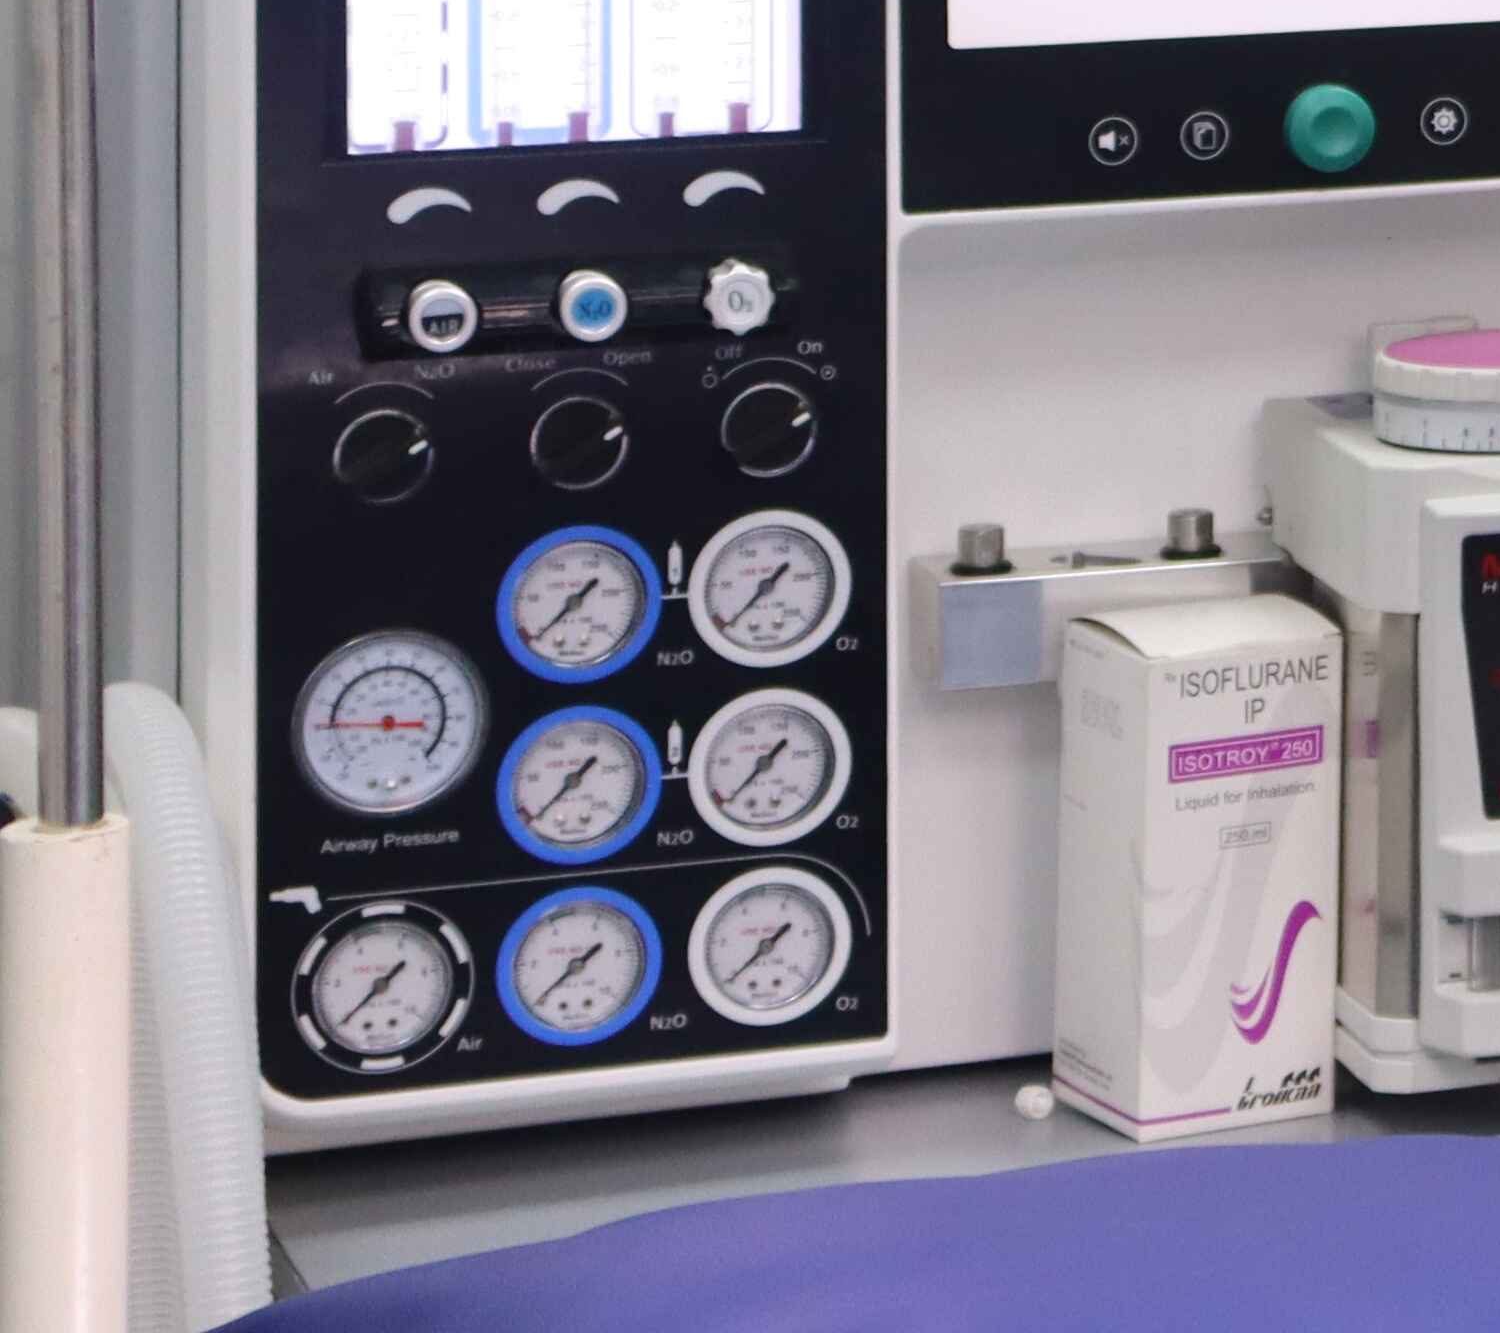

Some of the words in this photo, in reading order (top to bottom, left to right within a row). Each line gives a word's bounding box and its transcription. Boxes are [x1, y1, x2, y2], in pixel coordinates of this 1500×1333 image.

[503, 355, 557, 373] Close
[602, 348, 653, 368] Open
[714, 343, 744, 361] Off
[796, 339, 823, 356] On
[308, 369, 335, 385] Air
[656, 650, 695, 667] N2O
[1179, 655, 1329, 699] ISOFLURANE
[1244, 698, 1266, 724] IP
[1281, 739, 1313, 760] 250
[1175, 794, 1220, 813] Liquid
[1223, 790, 1244, 805] for
[1248, 781, 1316, 800] Inhalation
[320, 836, 379, 854] Airway
[383, 829, 461, 849] Pressure
[656, 830, 695, 847] N2O
[1223, 828, 1249, 845] 250
[649, 1014, 688, 1031] N2O
[456, 1036, 484, 1052] Air
